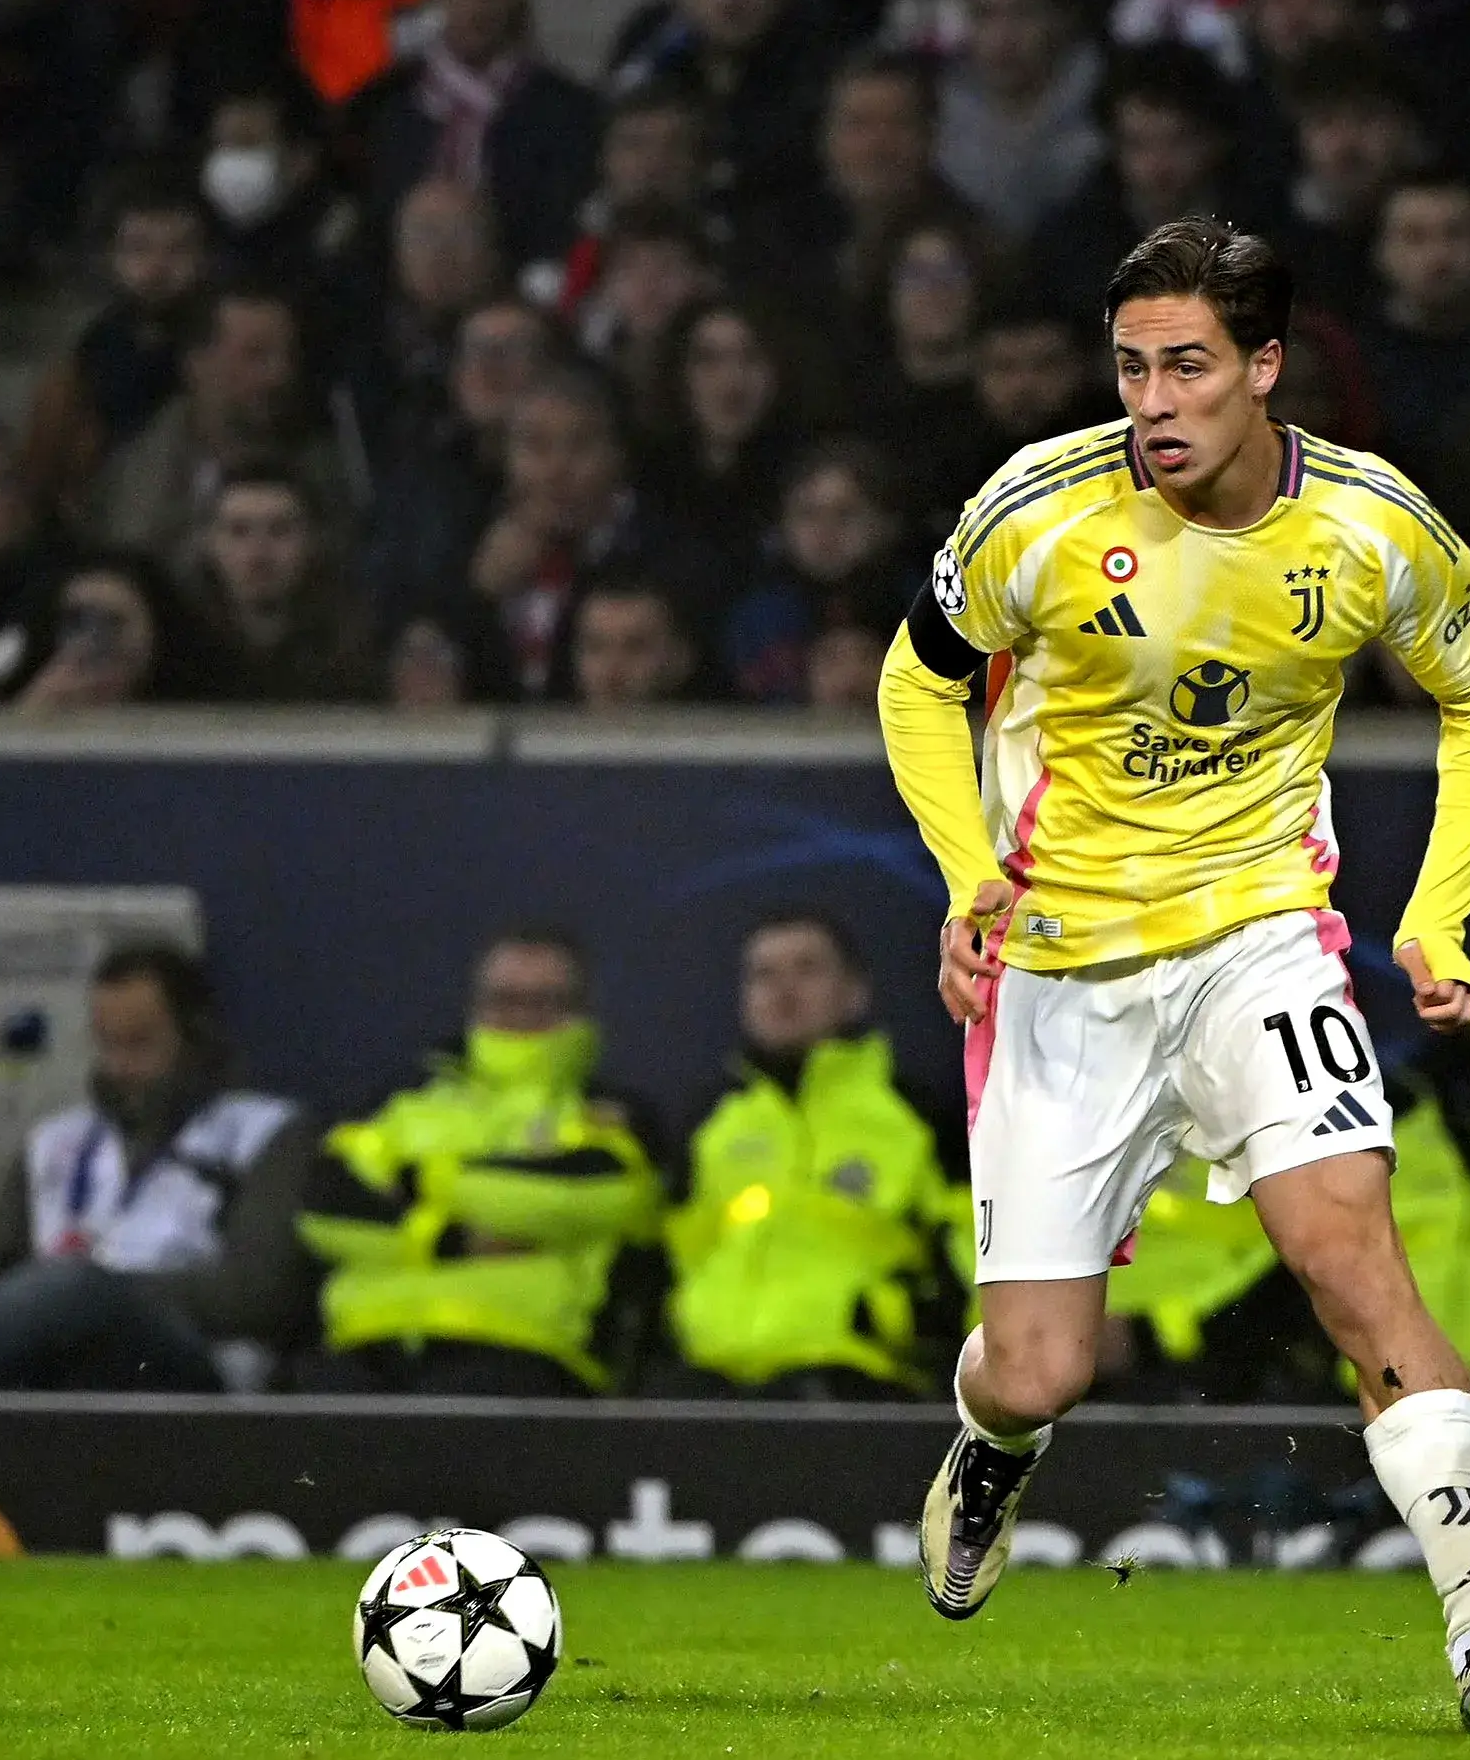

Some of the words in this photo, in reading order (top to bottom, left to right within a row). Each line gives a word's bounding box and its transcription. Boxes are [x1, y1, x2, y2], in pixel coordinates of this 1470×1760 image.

[1130, 722, 1210, 753] Save
[1122, 748, 1261, 783] Children
[1262, 1005, 1371, 1094] 10
